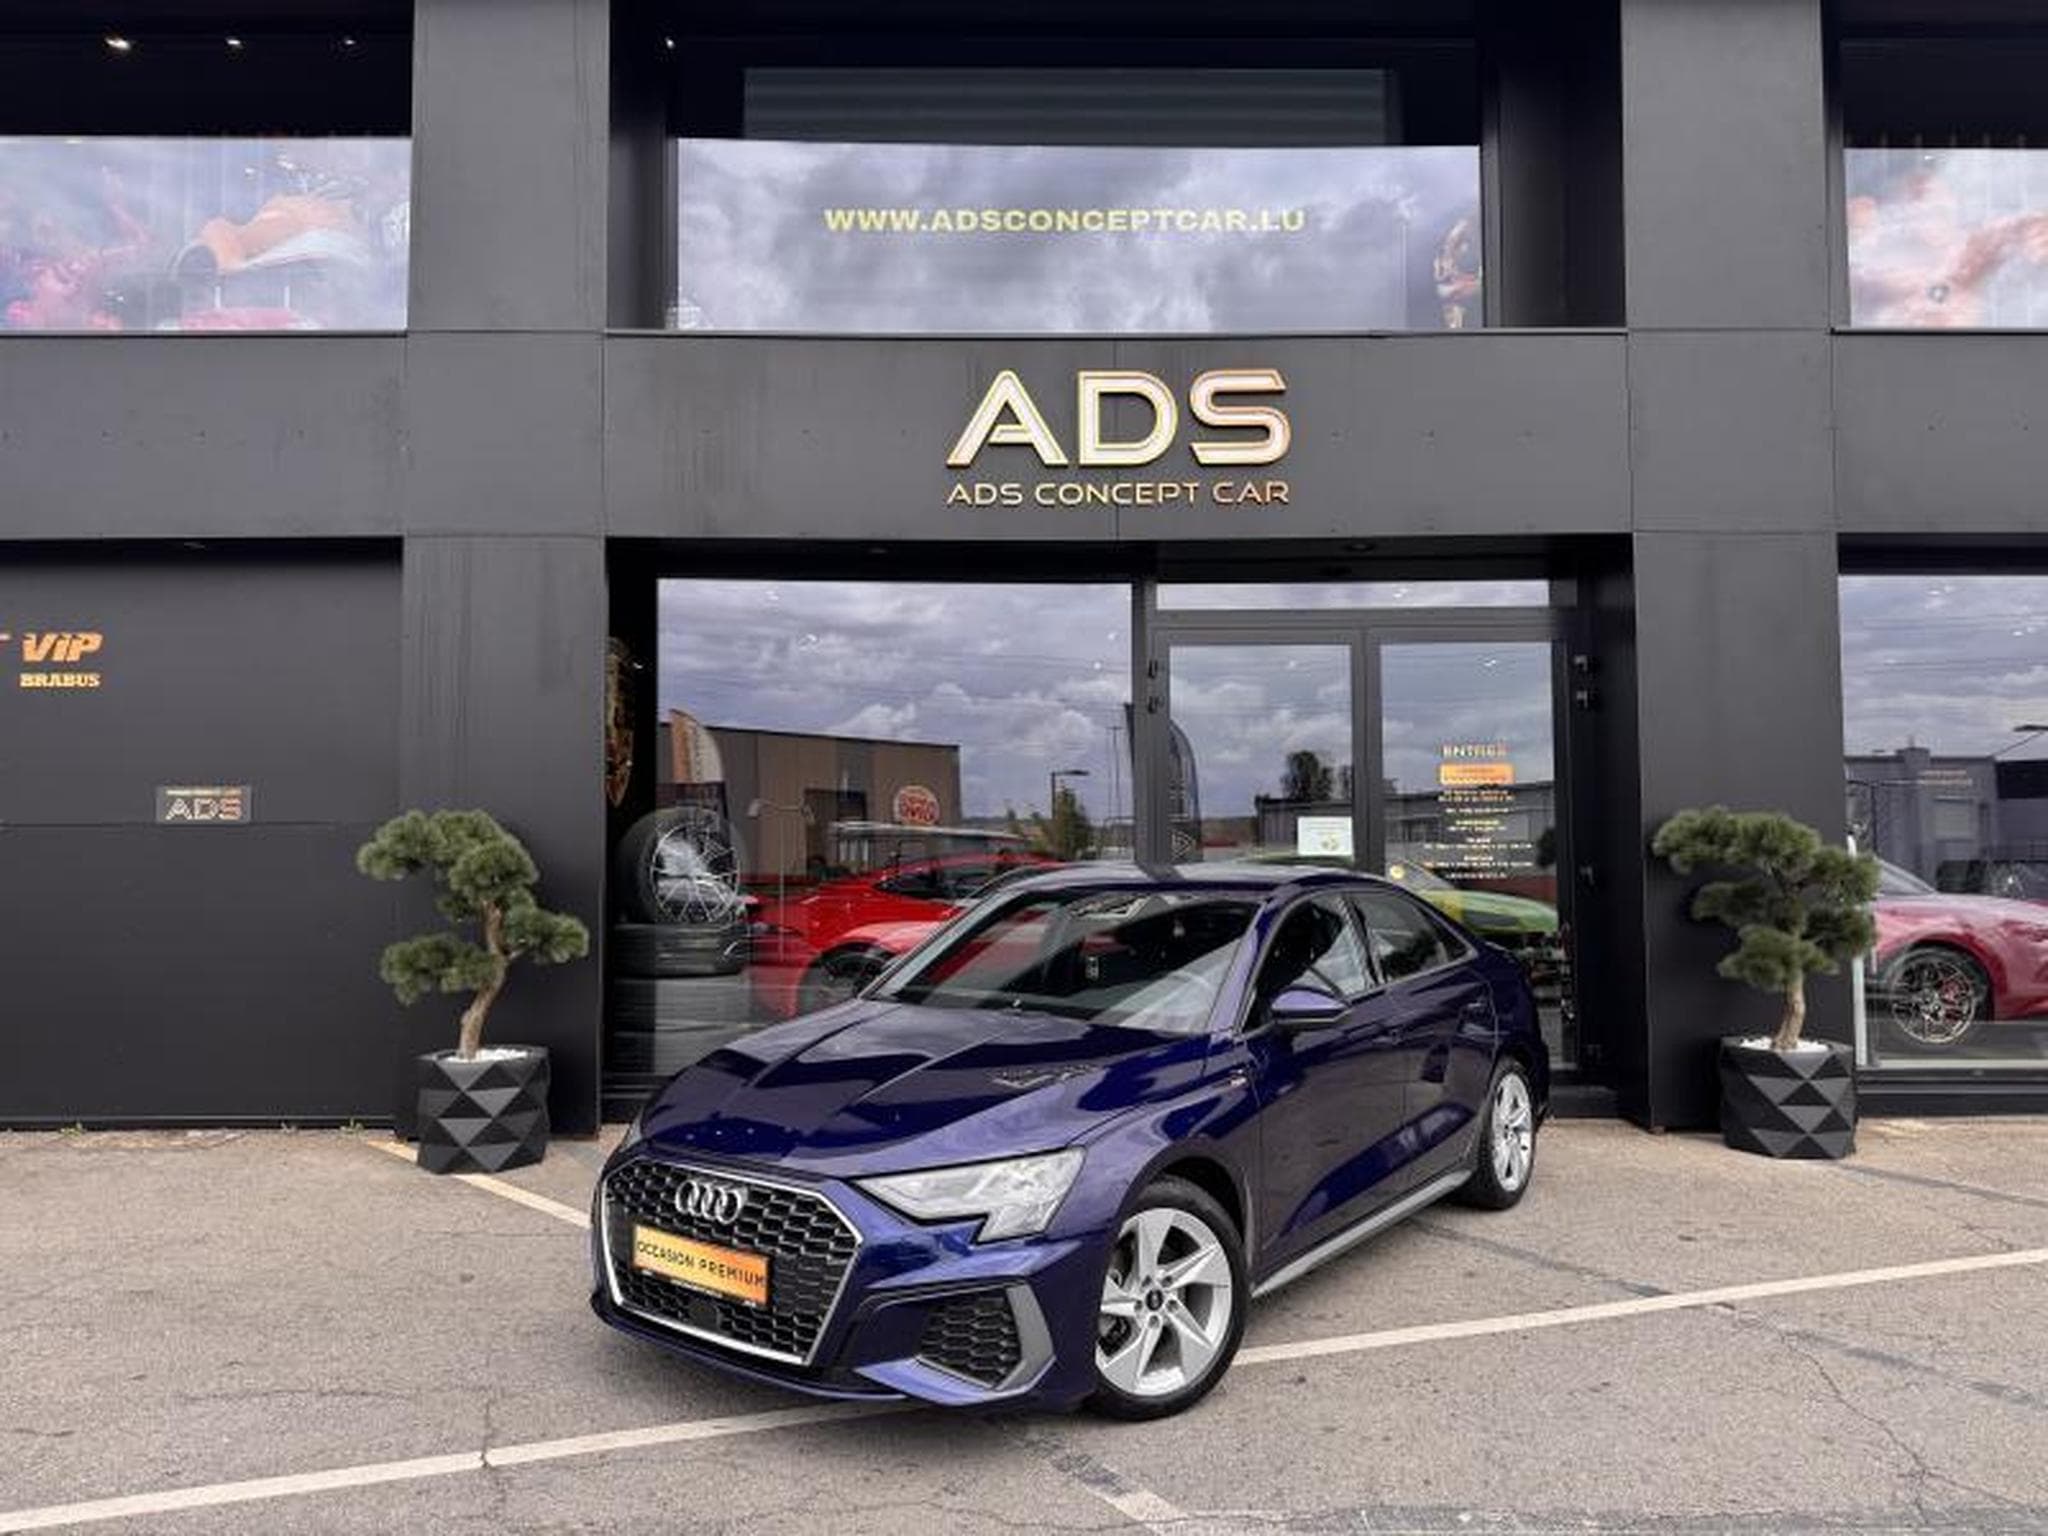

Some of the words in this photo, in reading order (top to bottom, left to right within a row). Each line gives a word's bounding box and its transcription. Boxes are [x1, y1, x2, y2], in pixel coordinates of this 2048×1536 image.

[824, 208, 1306, 232] WWW.ADSCONCEPTCAR.LU
[946, 369, 1292, 466] ADS
[948, 484, 1022, 506] ADS
[1035, 484, 1199, 506] CONCEPT
[1212, 482, 1290, 505] CAR
[20, 673, 100, 688] BRABUS
[165, 798, 241, 820] ADS
[637, 1241, 695, 1267] OCCASION
[698, 1258, 765, 1287] PREMIUM
